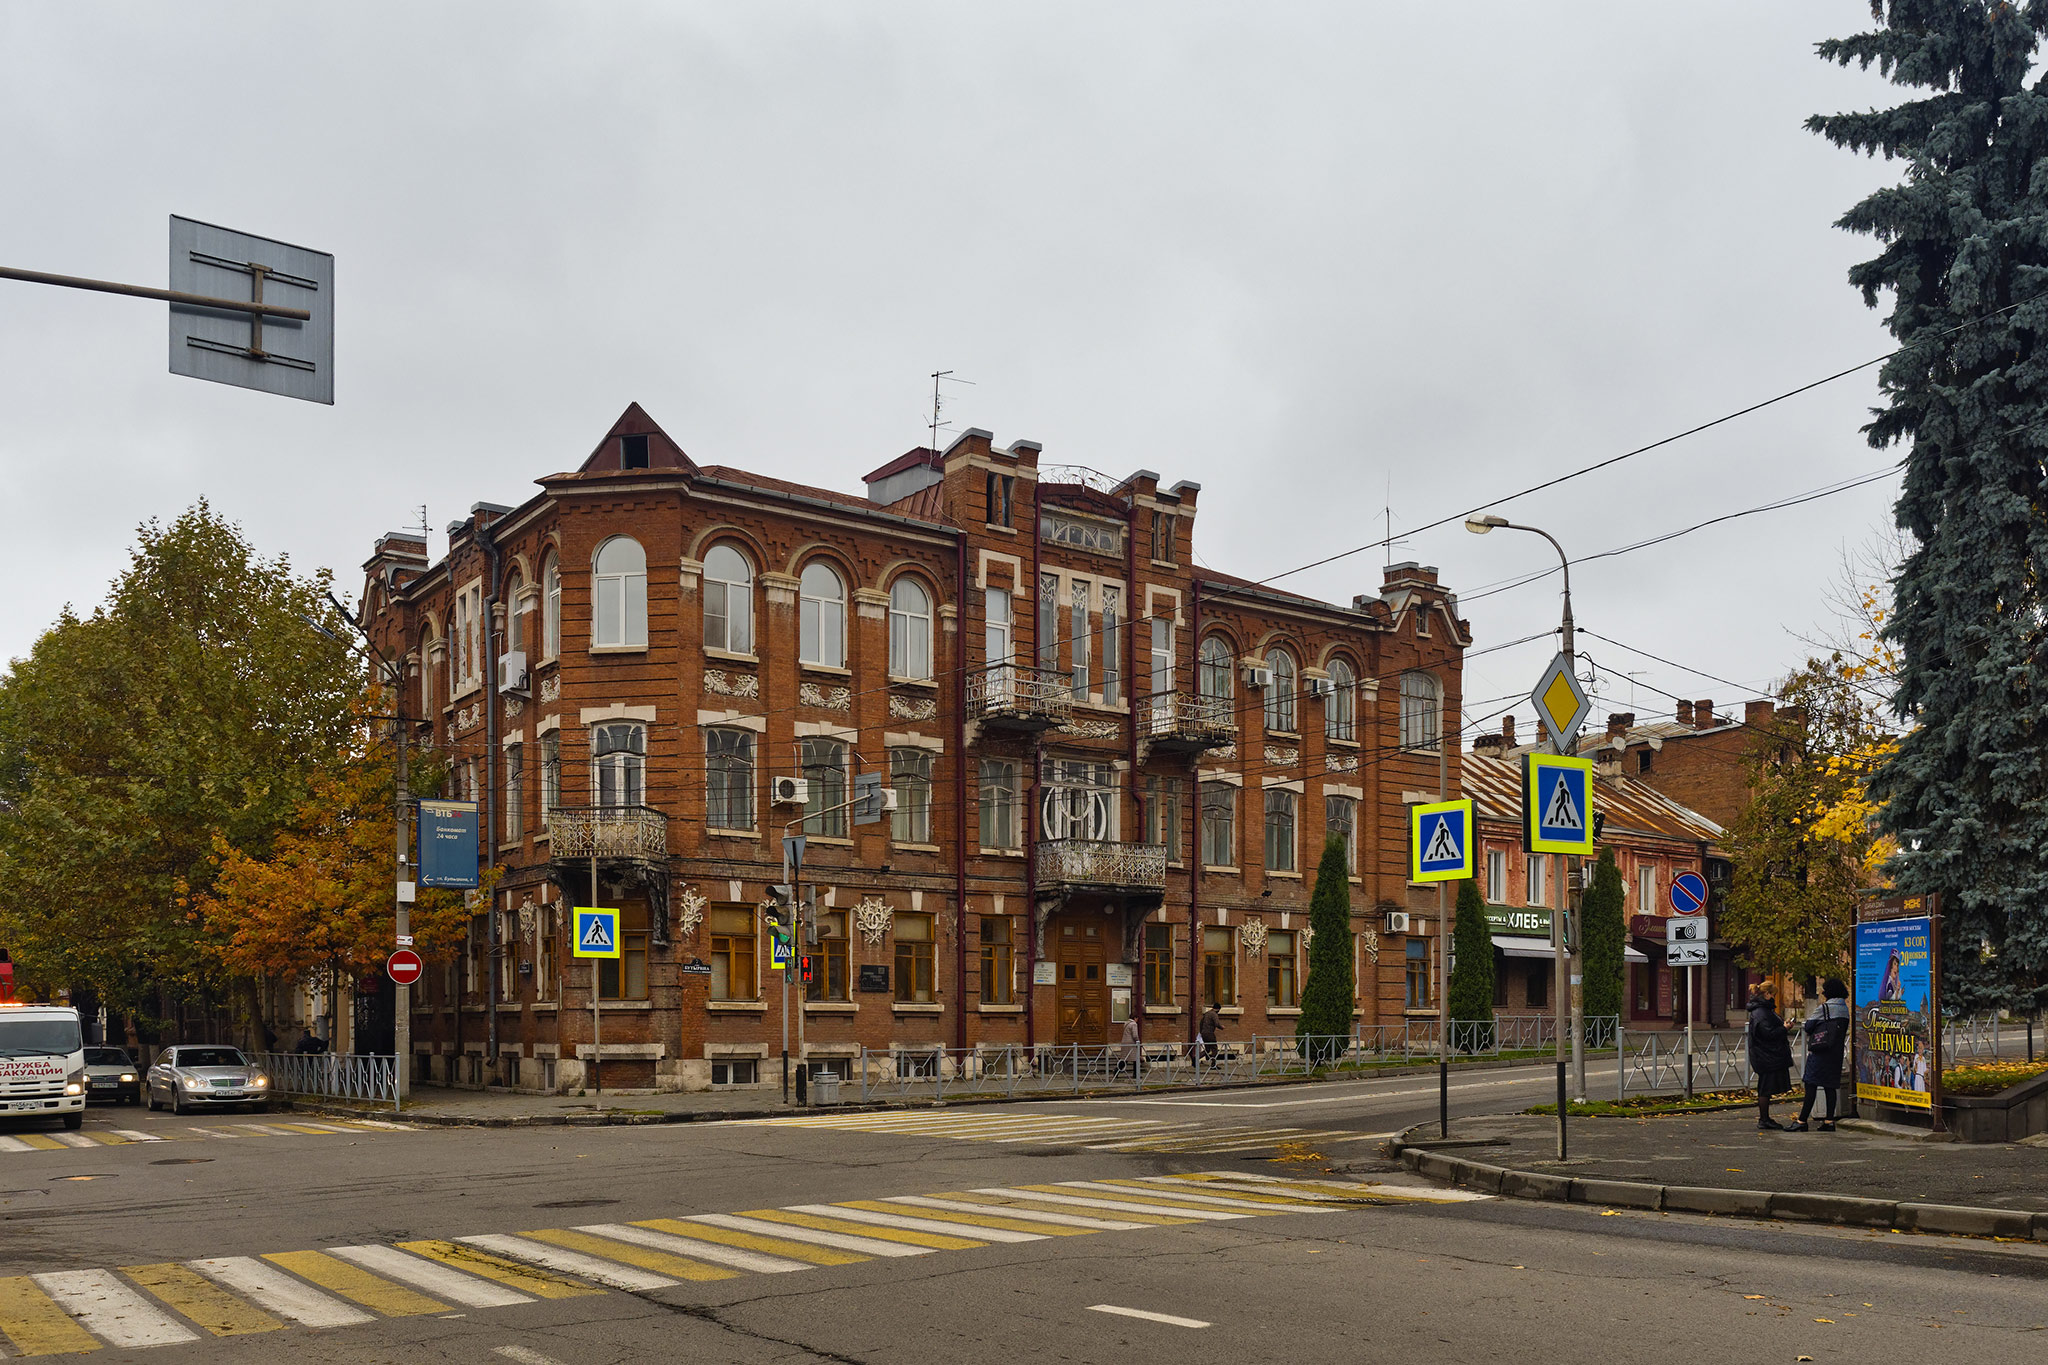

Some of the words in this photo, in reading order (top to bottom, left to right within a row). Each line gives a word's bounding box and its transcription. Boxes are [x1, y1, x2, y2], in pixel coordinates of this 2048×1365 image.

[1507, 912, 1538, 929] ХЛЕБ
[1904, 937, 1911, 947] КЗ
[1911, 936, 1927, 948] СОГУ
[1900, 951, 1909, 966] 20
[1868, 1032, 1915, 1055] ХАНУМЫ
[0, 1061, 51, 1070] СЛУЖБА
